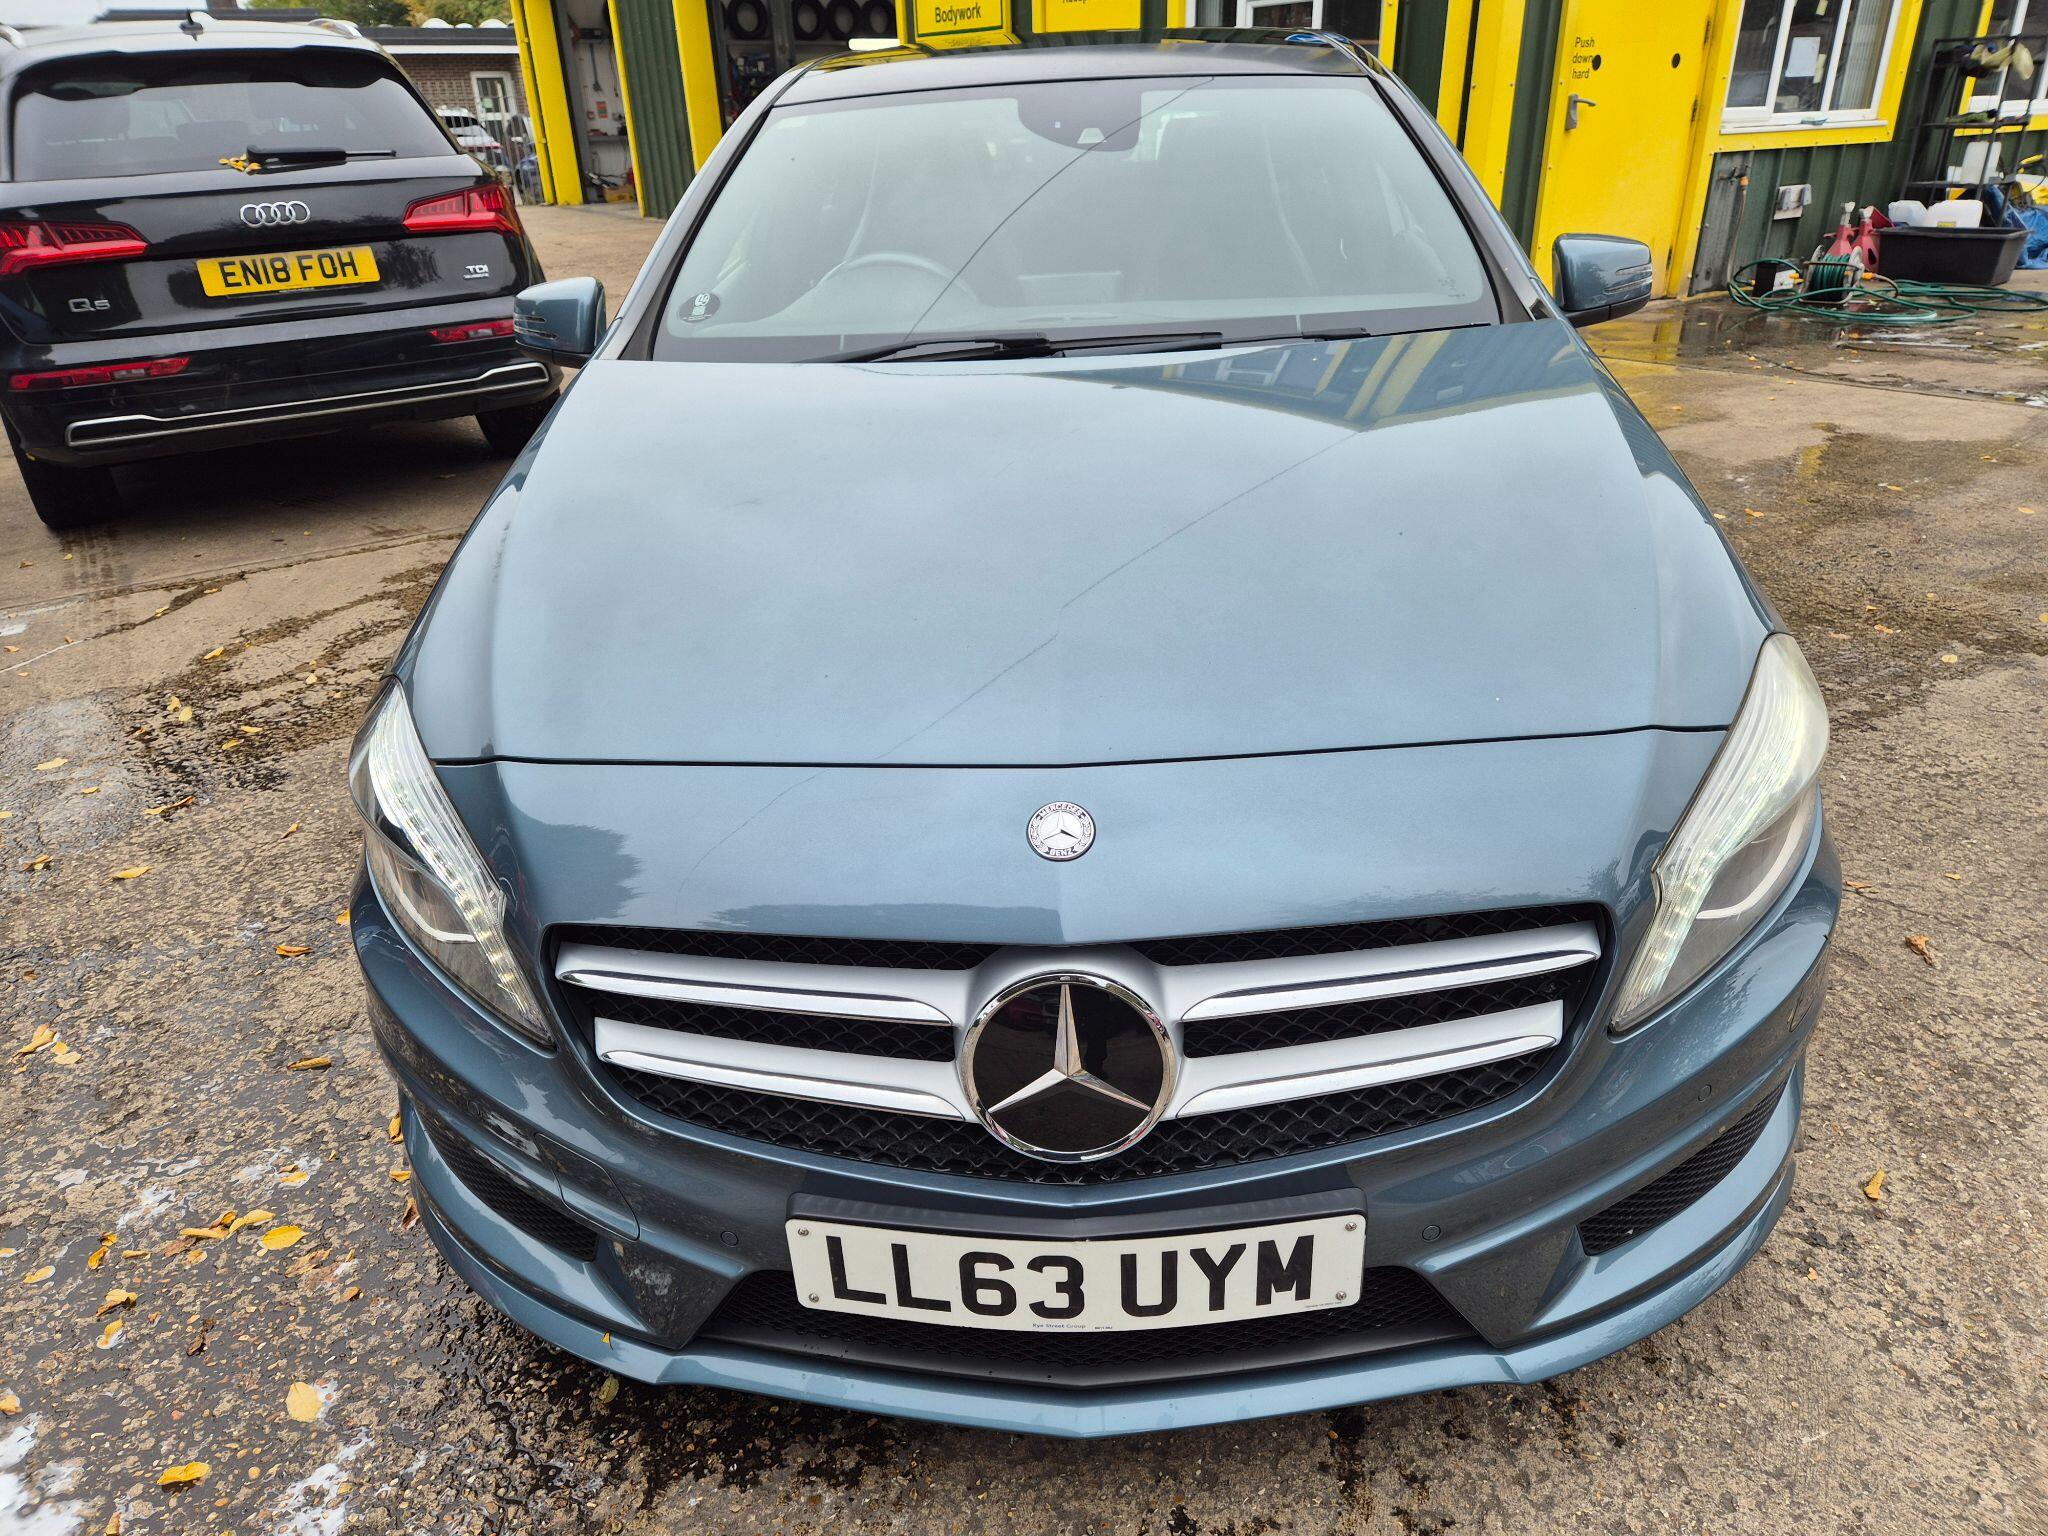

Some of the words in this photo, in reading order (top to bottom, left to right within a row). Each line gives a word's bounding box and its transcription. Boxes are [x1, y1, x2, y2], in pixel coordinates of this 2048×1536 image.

[935, 3, 982, 26] Bodywork
[1575, 37, 1595, 48] Push
[1572, 52, 1594, 64] down
[1572, 67, 1591, 79] hard
[218, 256, 291, 288] EN18
[296, 251, 359, 281] FOH
[465, 264, 489, 274] TDI
[68, 298, 110, 312] Q5
[1049, 846, 1073, 856] BENZ
[826, 1236, 1086, 1320] LL63
[1120, 1235, 1315, 1318] UYM
